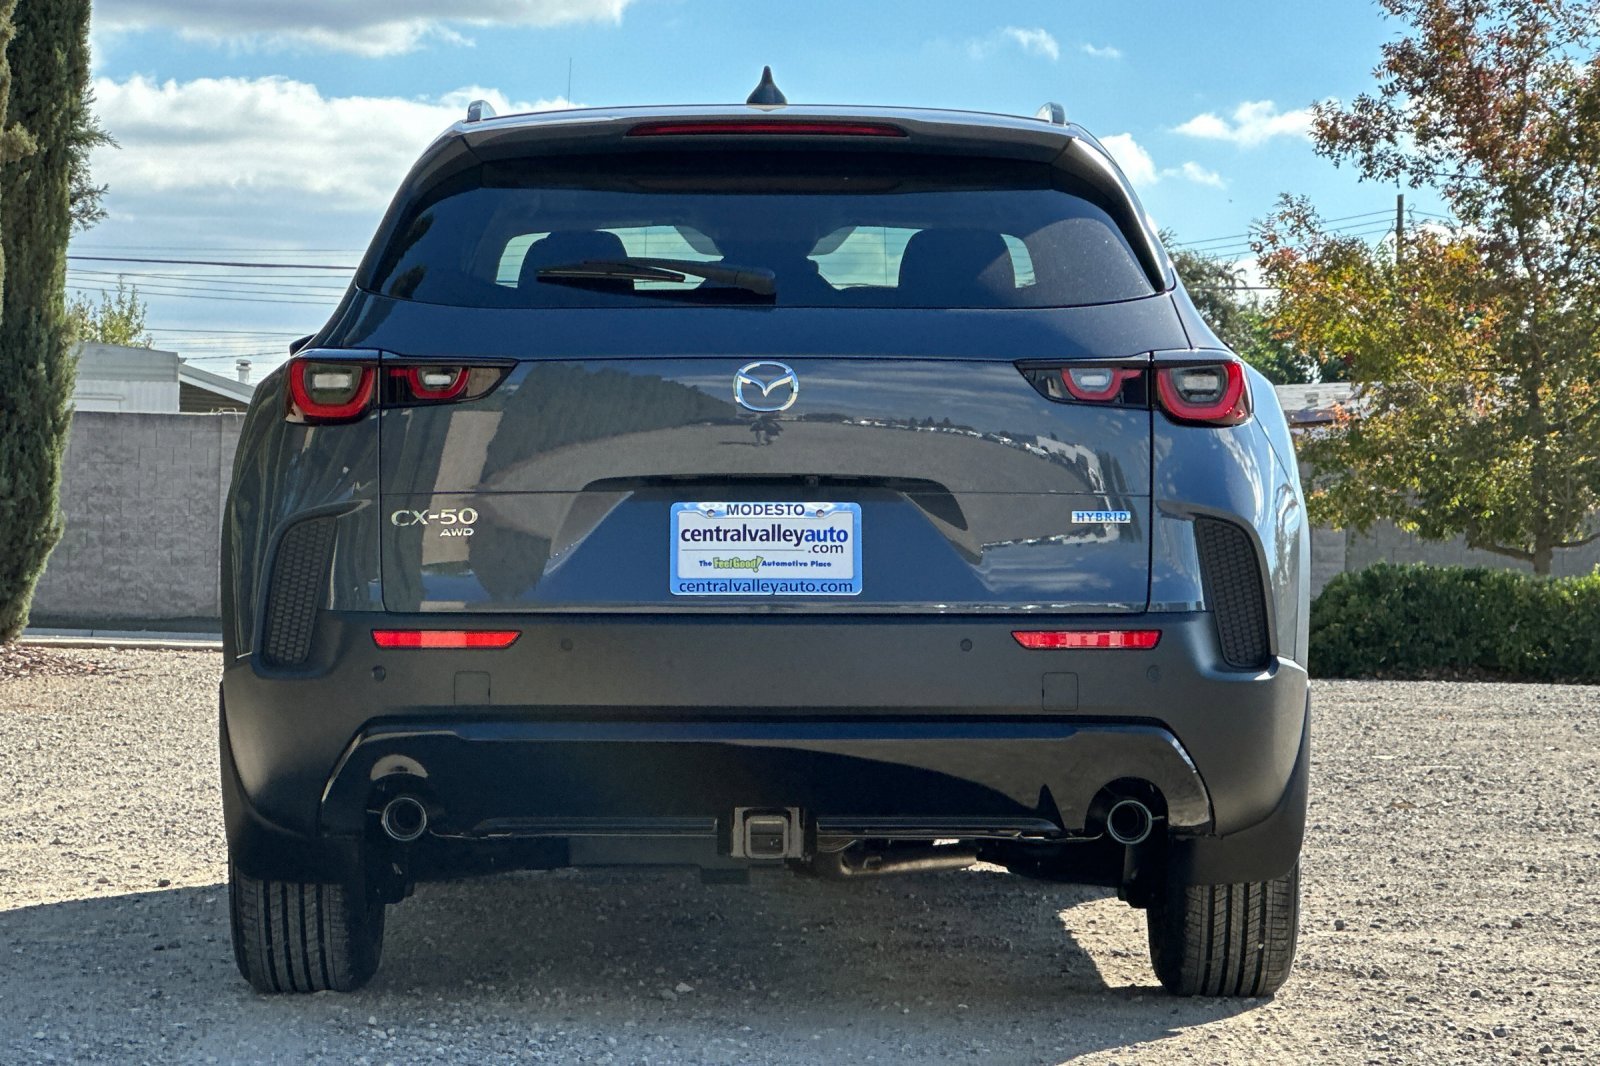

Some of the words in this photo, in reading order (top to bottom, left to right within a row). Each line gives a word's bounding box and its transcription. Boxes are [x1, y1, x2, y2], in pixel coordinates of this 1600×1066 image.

[726, 504, 805, 516] MODESTO
[391, 507, 478, 527] CX-50
[1075, 512, 1128, 522] HYBRID
[440, 527, 475, 537] AWD
[681, 524, 848, 547] centralvalleyauto
[807, 544, 844, 554] .com
[679, 579, 853, 595] centralvalleyauto.com
